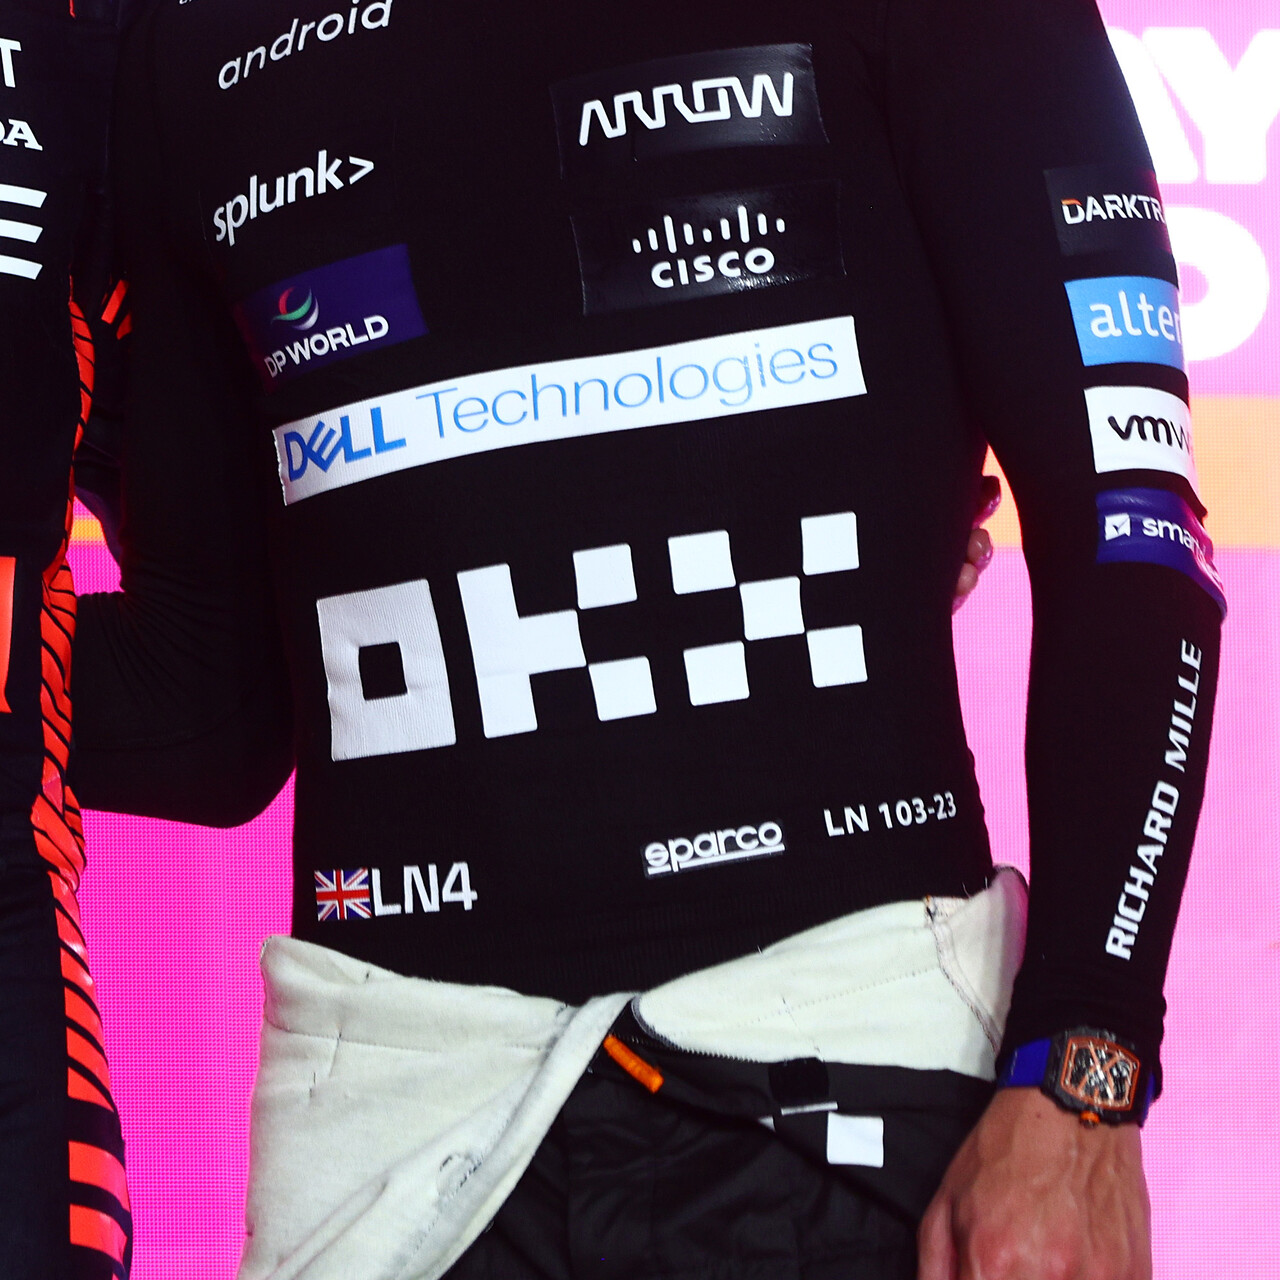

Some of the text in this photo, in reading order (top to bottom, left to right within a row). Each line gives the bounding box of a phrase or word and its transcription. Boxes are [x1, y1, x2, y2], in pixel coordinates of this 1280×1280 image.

[578, 71, 795, 145] ARROW
[264, 315, 389, 378] DP WORLD
[284, 340, 839, 482] DELL Technologies
[315, 512, 868, 761] OKX
[823, 793, 957, 837] LN 103-23
[1105, 638, 1202, 961] RICHARD MILLE
[645, 822, 784, 876] sparco
[371, 862, 478, 916] LN4
